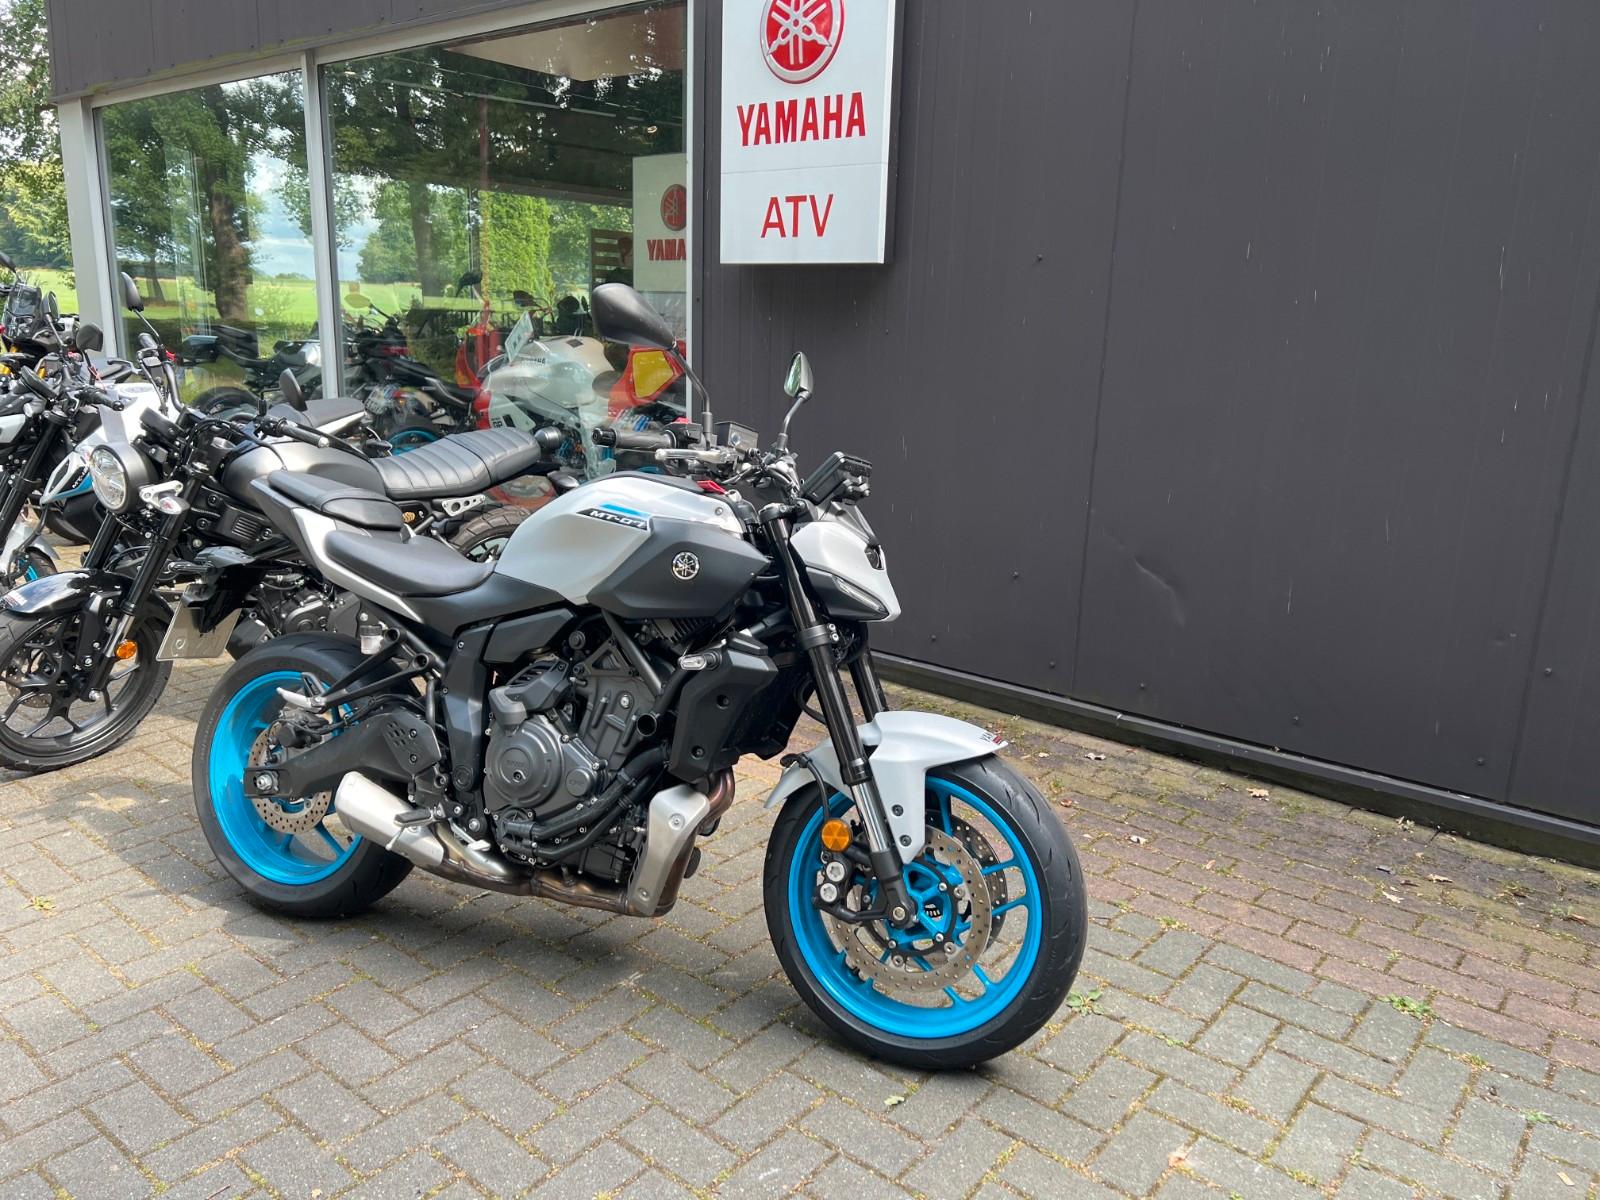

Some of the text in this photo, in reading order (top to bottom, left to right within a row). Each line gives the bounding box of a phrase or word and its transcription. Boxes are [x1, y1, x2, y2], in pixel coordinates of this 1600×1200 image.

[736, 92, 866, 147] YAMAHA
[760, 194, 834, 239] ATV
[647, 239, 687, 261] YAMA
[590, 510, 647, 529] MT-07
